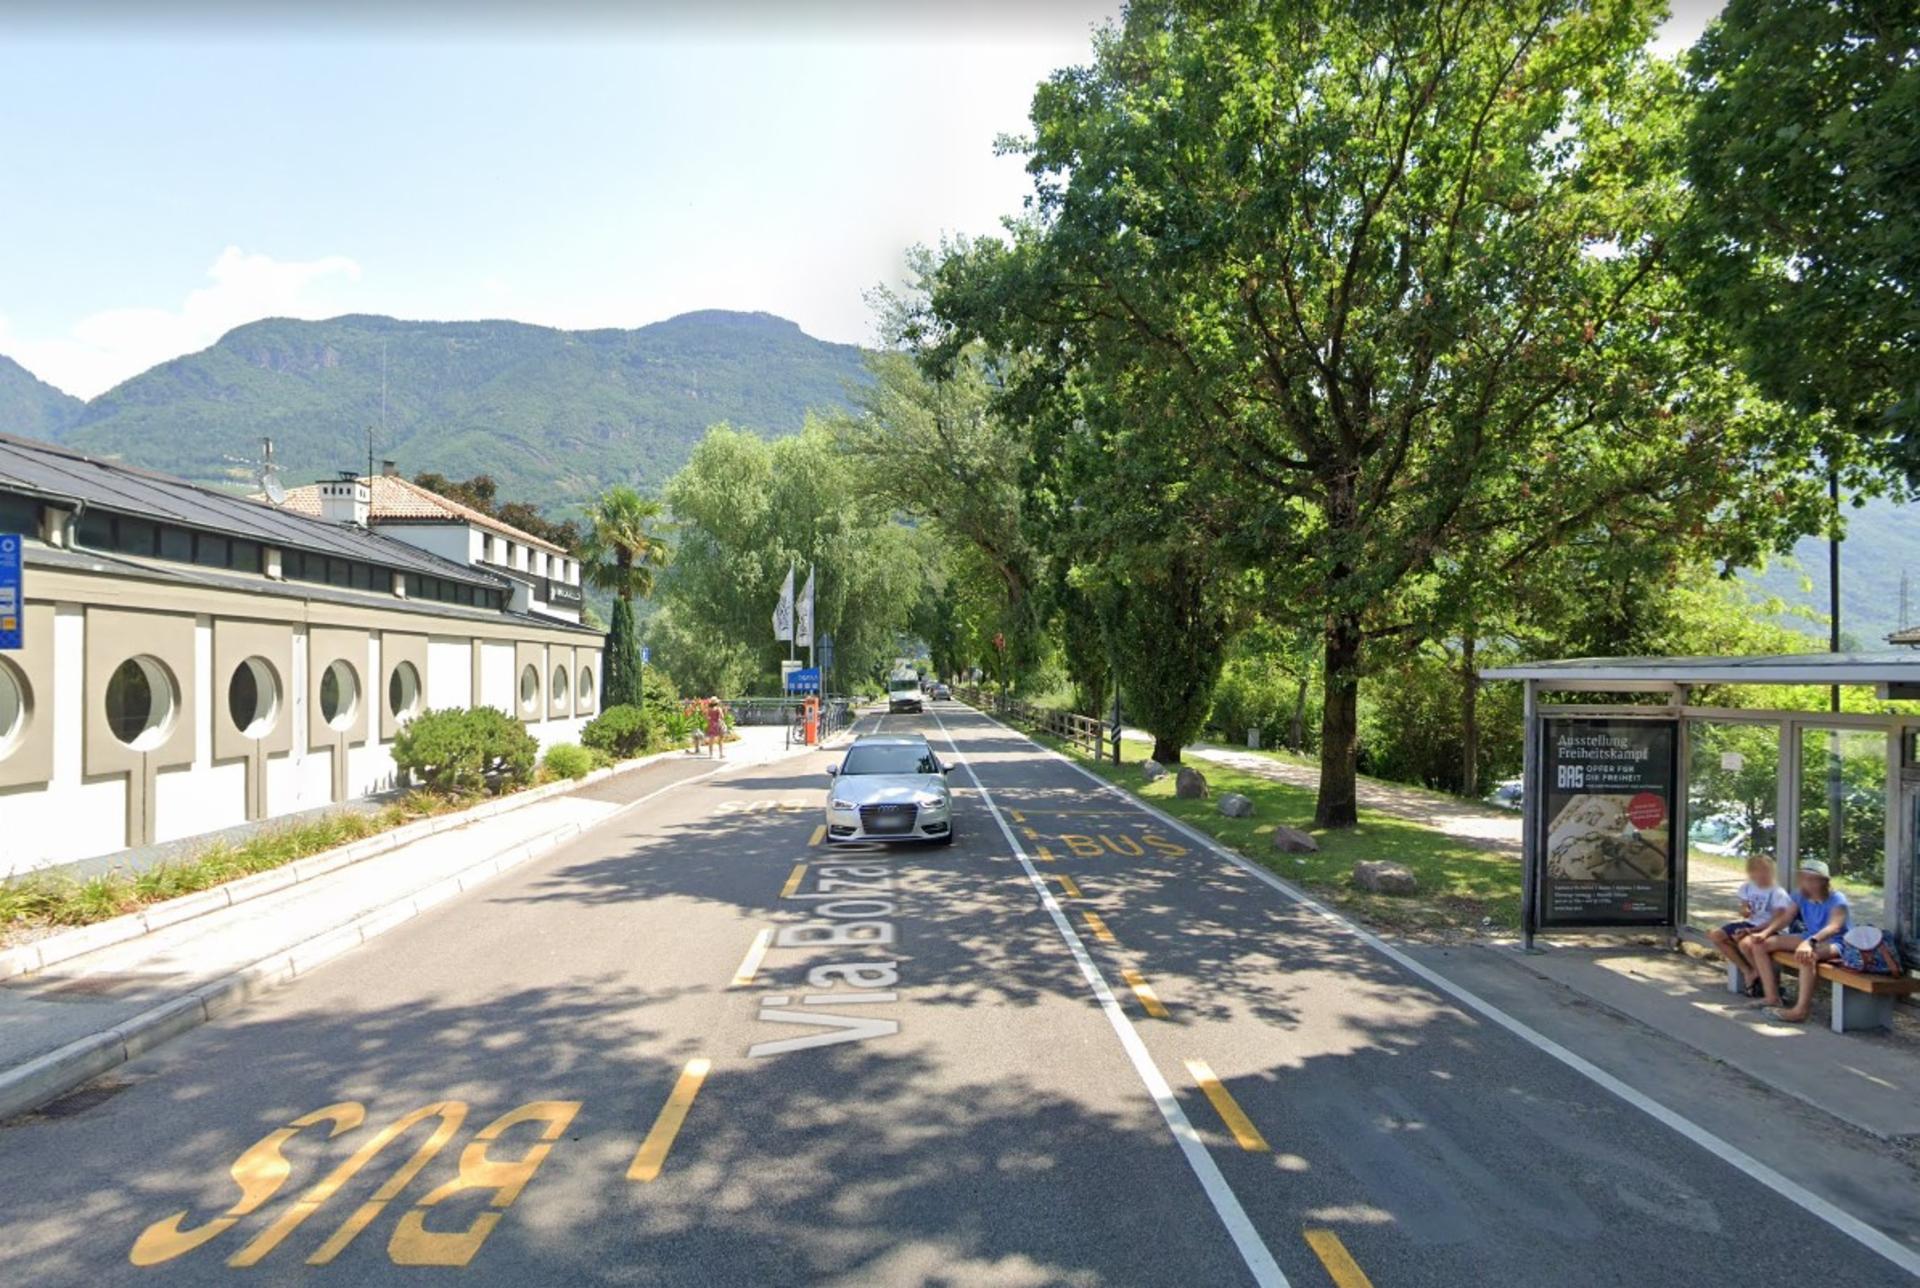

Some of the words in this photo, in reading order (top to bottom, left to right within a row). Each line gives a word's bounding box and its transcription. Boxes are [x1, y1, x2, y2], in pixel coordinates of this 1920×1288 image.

[1557, 734, 1628, 749] Ausstellung
[1558, 746, 1648, 762] Freiheitskampf
[1557, 764, 1584, 788] BAS
[1602, 774, 1642, 782] FREIHEIT
[1060, 834, 1188, 856] BUS
[129, 1100, 583, 1267] BUS
